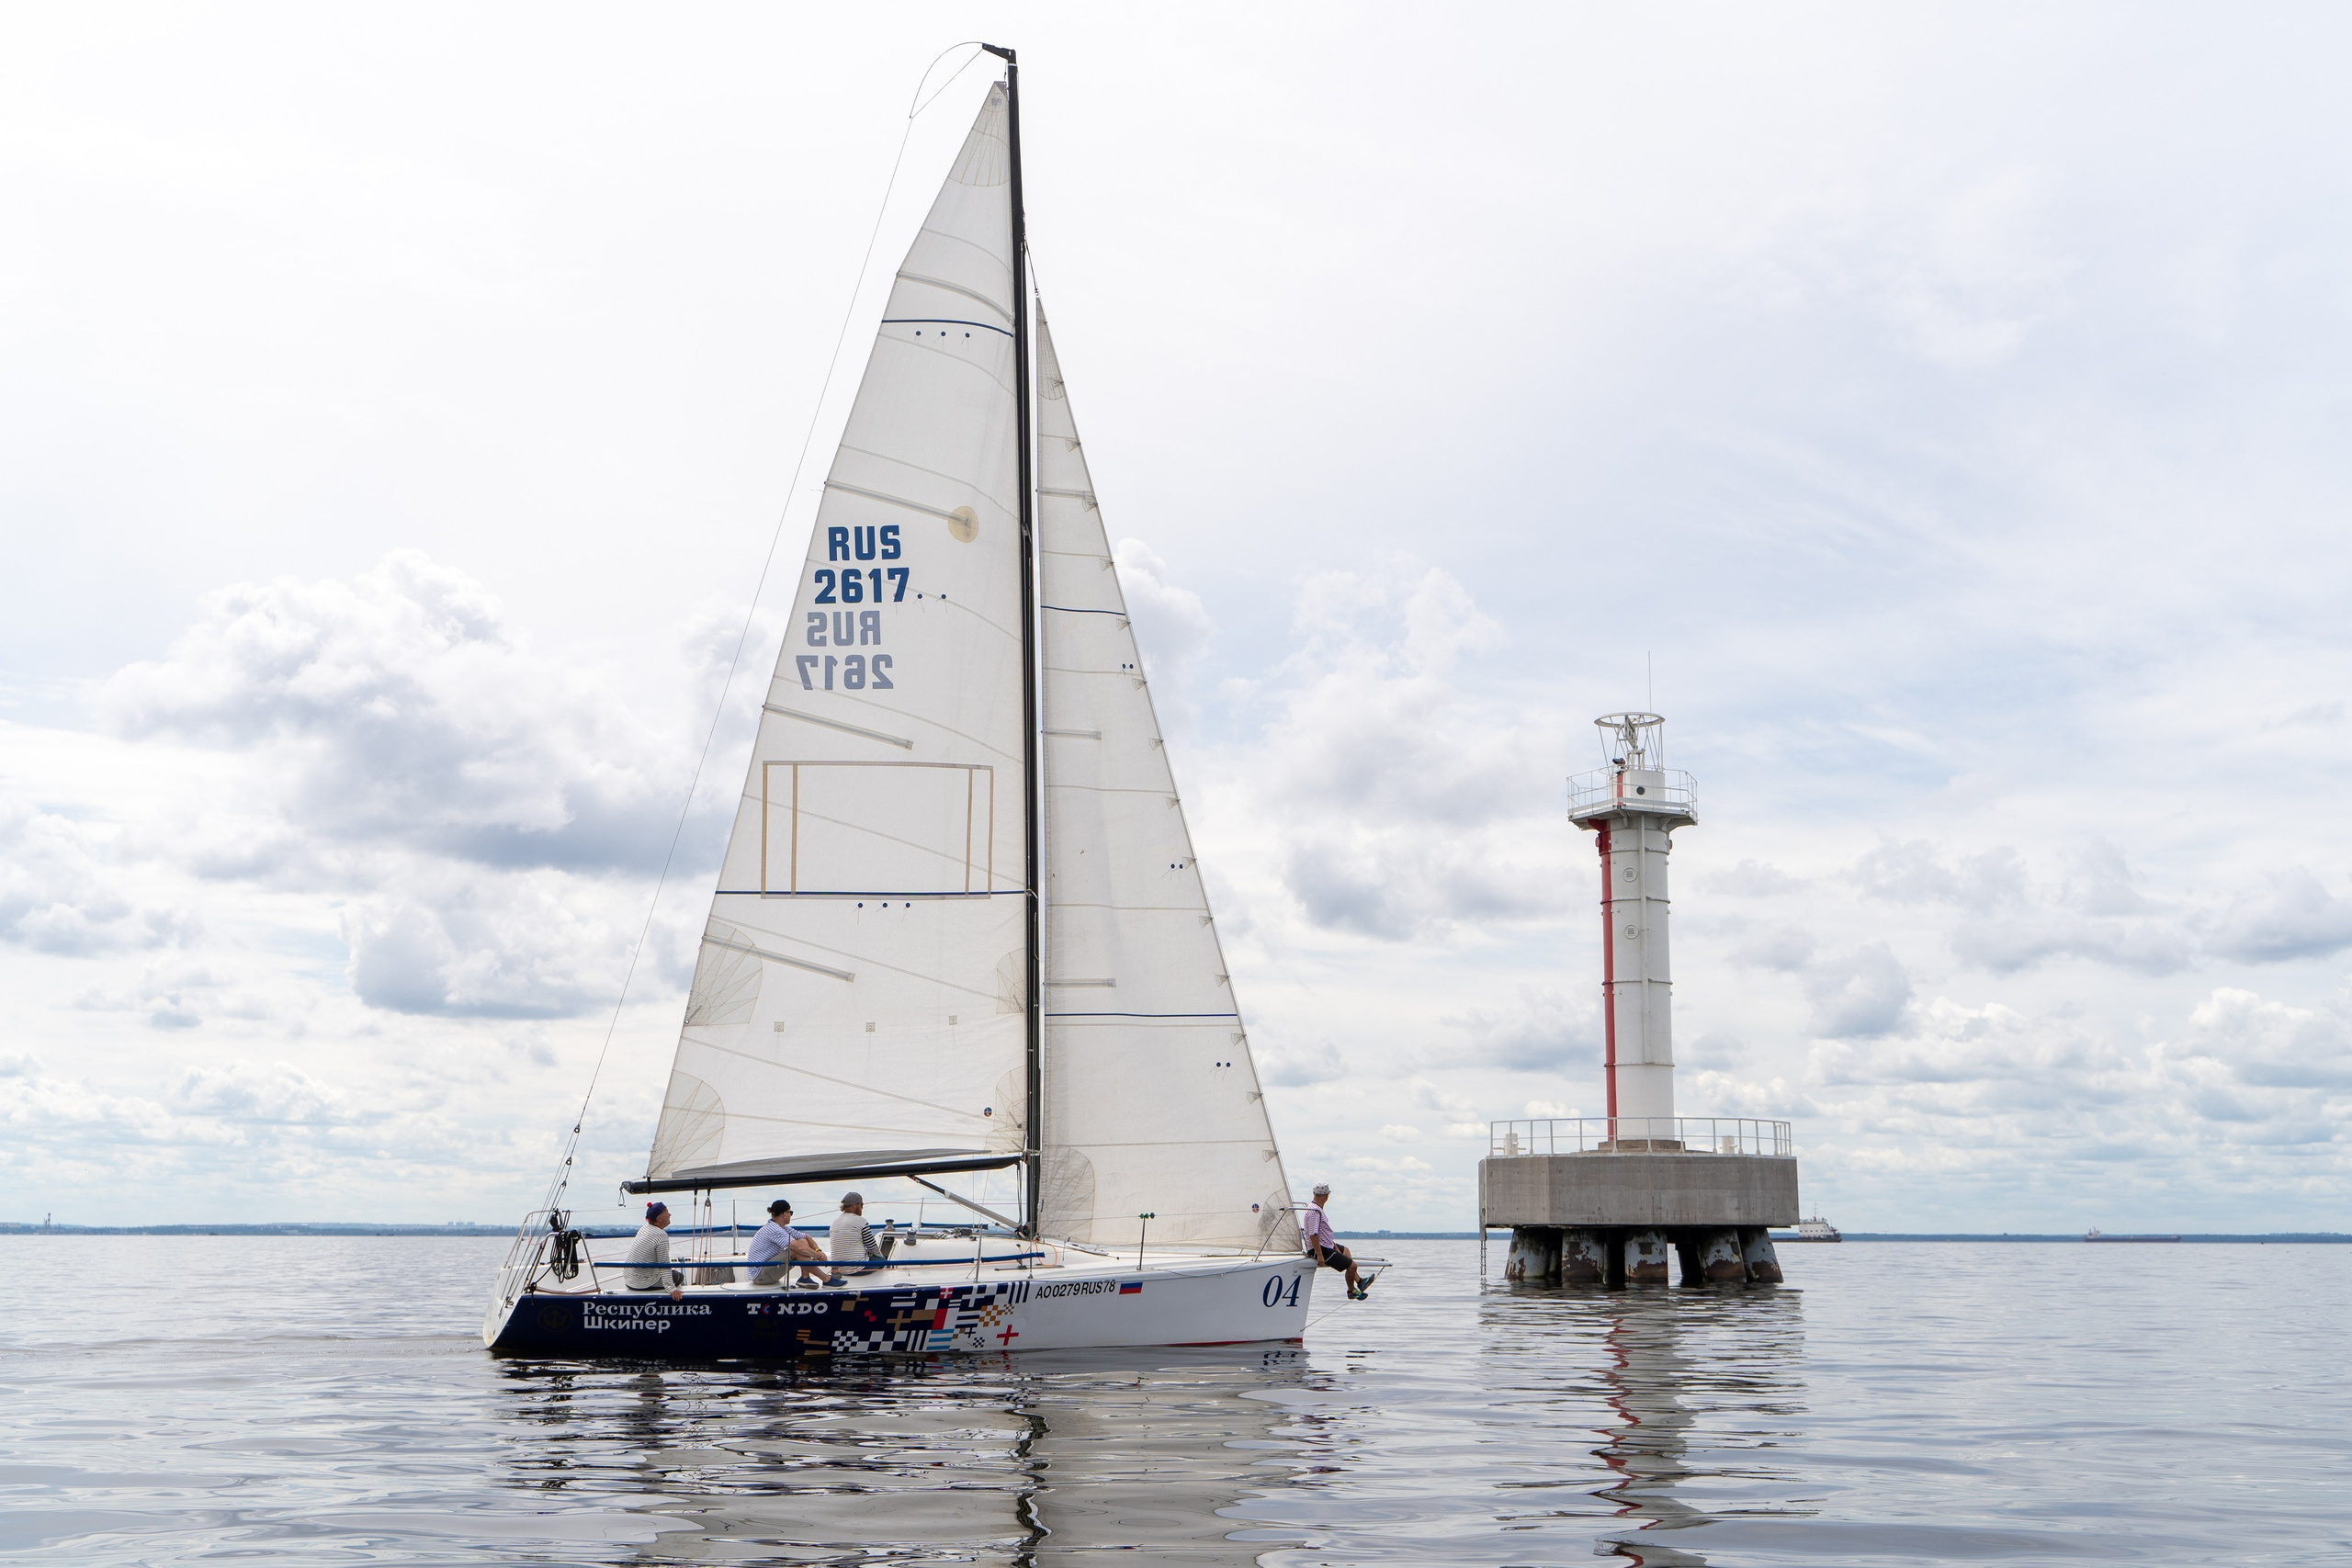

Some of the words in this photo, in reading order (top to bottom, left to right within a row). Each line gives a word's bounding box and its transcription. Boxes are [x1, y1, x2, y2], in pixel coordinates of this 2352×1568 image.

[829, 525, 901, 561] RUS
[814, 567, 910, 604] 2617
[1262, 1275, 1302, 1307] 04
[582, 1302, 712, 1319] Республика
[583, 1315, 671, 1333] Шкипер
